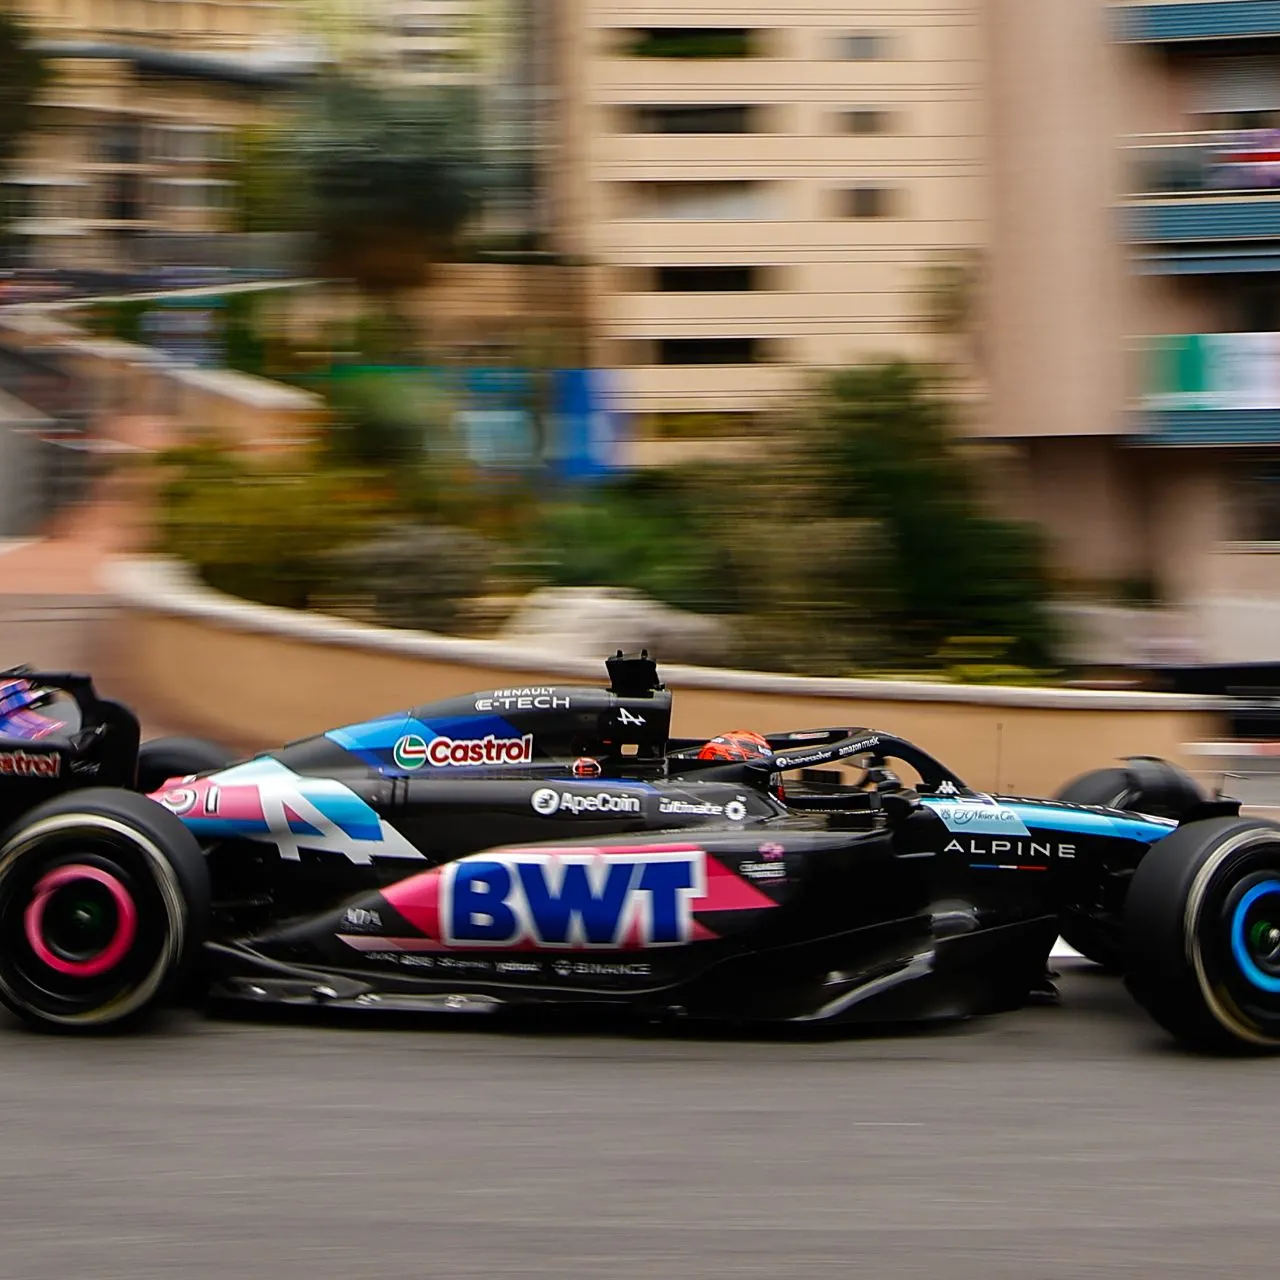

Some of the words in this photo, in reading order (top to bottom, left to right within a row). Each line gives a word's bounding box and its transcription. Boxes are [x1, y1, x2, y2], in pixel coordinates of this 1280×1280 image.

[493, 687, 556, 697] RENAULT
[476, 696, 570, 711] E-TECH
[429, 734, 533, 766] Castrol
[838, 742, 862, 756] amazon
[862, 736, 880, 749] music
[560, 793, 641, 815] ApeCoin
[943, 839, 1076, 859] ALPINE
[451, 860, 693, 944] BWT
